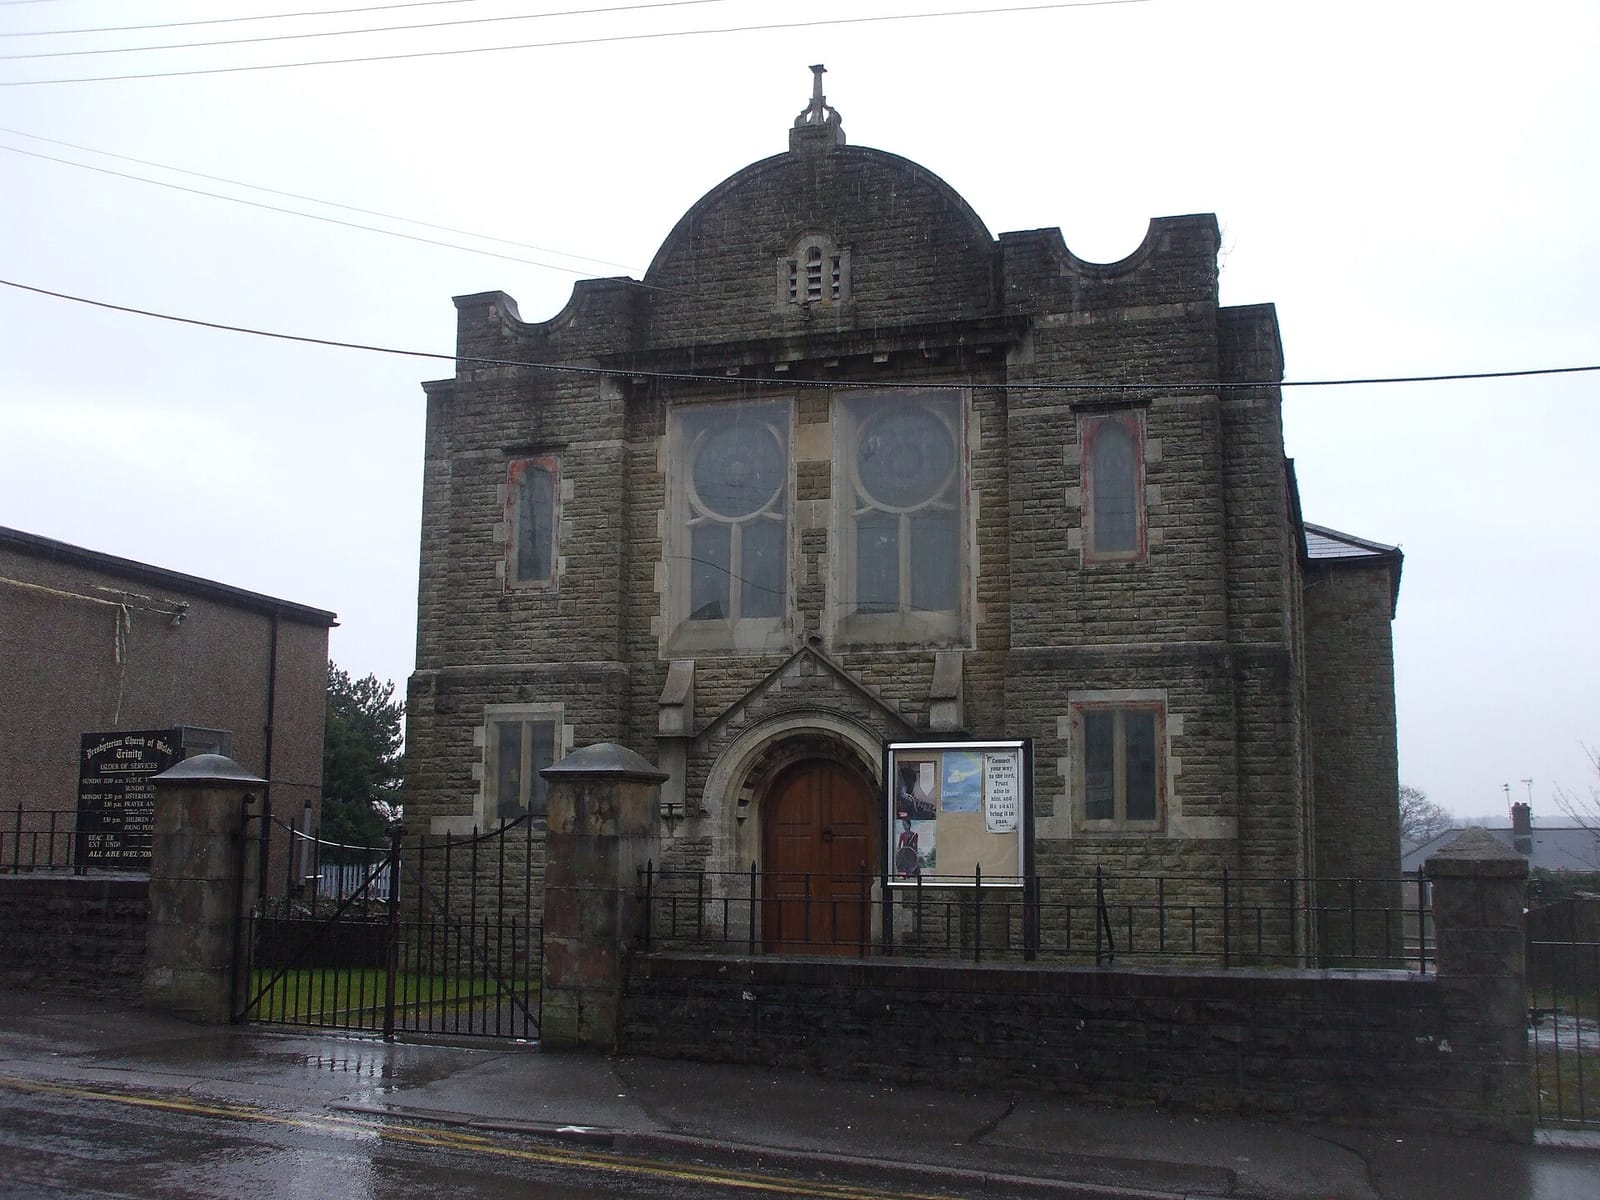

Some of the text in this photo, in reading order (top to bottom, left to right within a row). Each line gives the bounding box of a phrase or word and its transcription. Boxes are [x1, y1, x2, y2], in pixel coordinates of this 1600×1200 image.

[86, 740, 123, 759] Presbyterian
[125, 736, 145, 747] Church
[147, 739, 154, 747] of
[116, 749, 143, 760] Trinity
[88, 850, 102, 858] ALL
